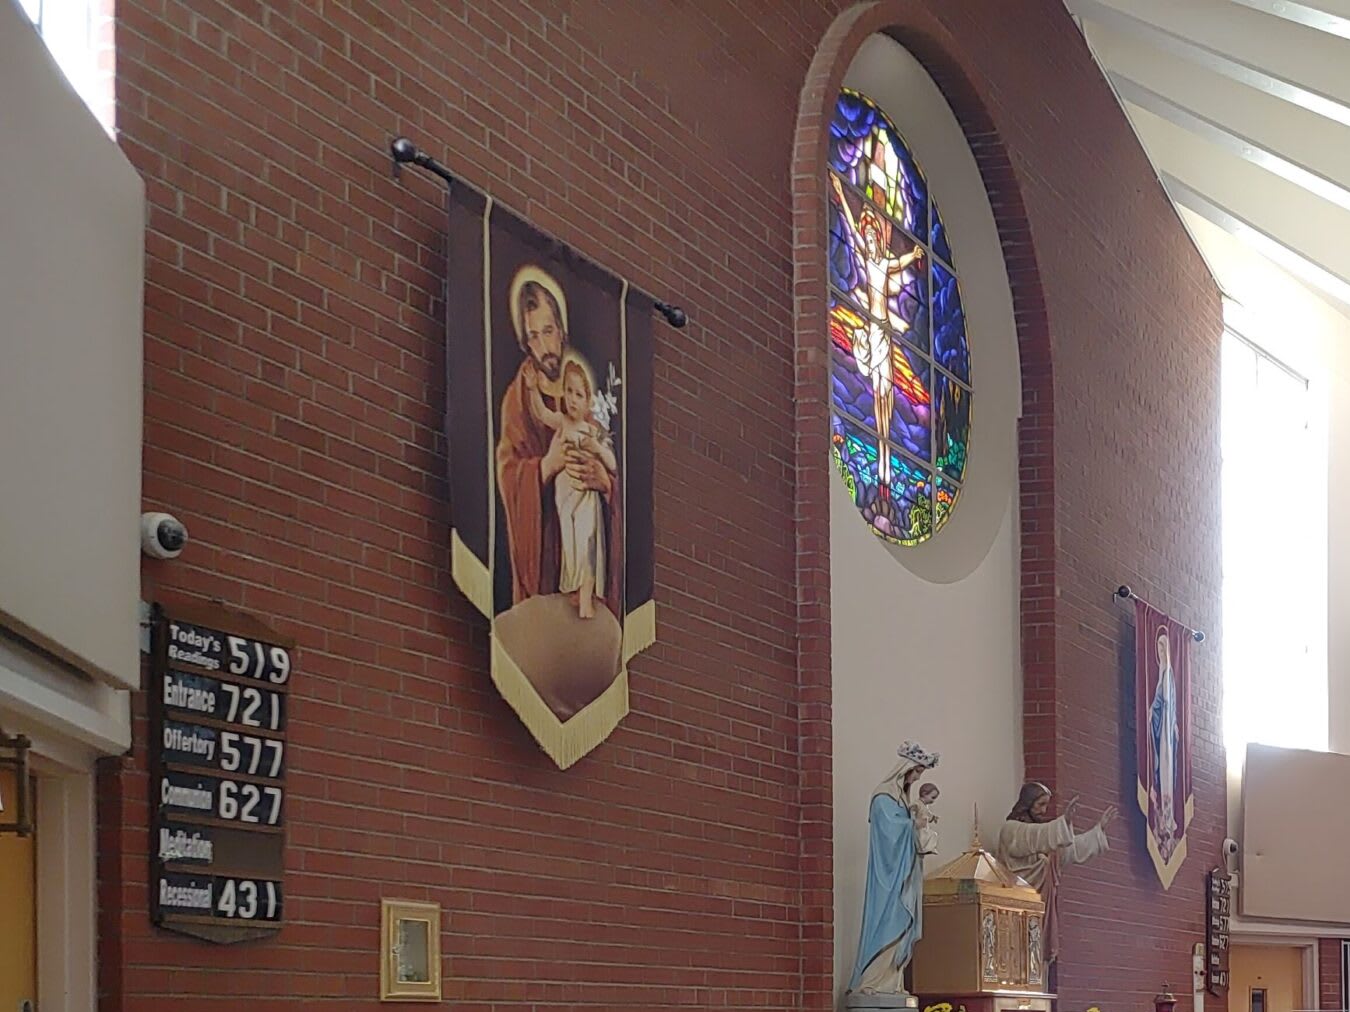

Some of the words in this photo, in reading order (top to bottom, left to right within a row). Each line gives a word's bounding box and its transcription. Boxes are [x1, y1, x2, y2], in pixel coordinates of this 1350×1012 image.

[168, 645, 220, 670] Readings
[169, 624, 222, 652] Today's
[228, 635, 290, 684] 519
[163, 675, 216, 713] Entrance
[221, 683, 280, 730] 721
[163, 727, 216, 761] Offertory
[220, 731, 283, 777] 577
[219, 780, 282, 825] 627
[159, 878, 213, 909] Recessional
[217, 879, 275, 918] 431
